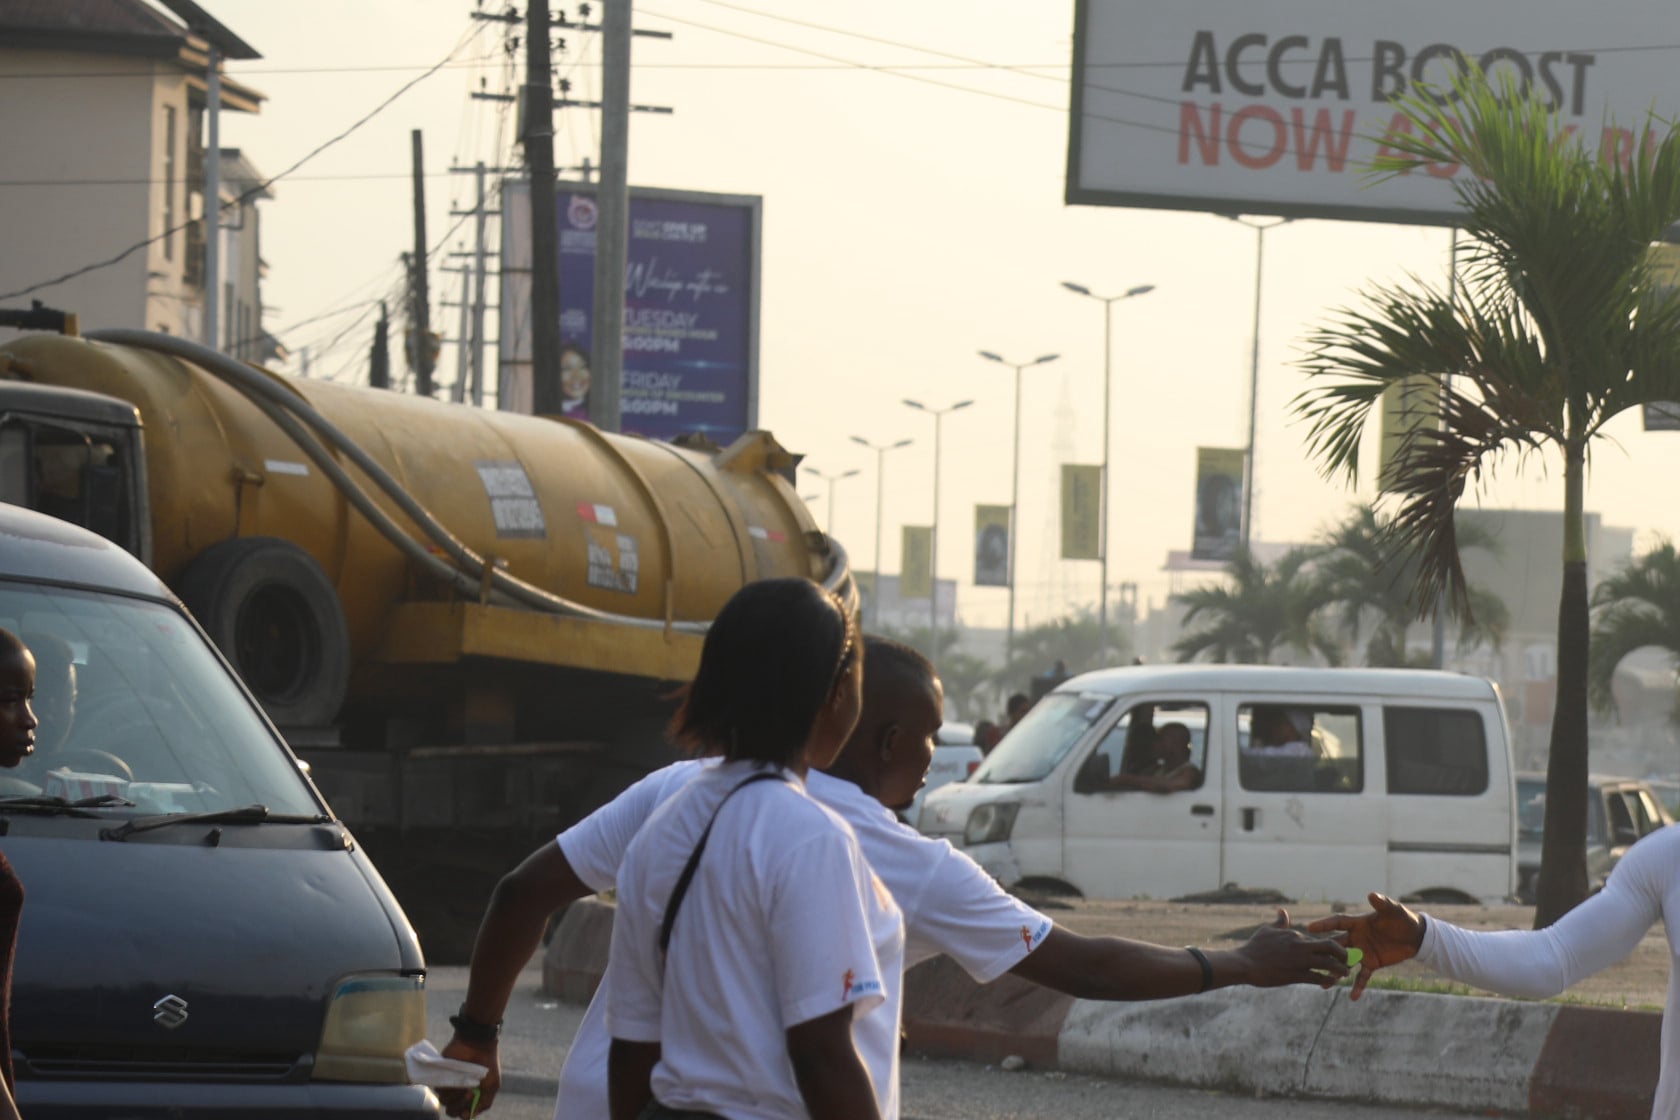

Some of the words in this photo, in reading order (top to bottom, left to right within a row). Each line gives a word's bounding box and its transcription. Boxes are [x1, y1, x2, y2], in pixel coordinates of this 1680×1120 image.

[1181, 30, 1350, 100] ACCA
[1371, 40, 1596, 116] BOOST
[1177, 101, 1356, 173] NOW
[621, 369, 682, 389] FRIDAY
